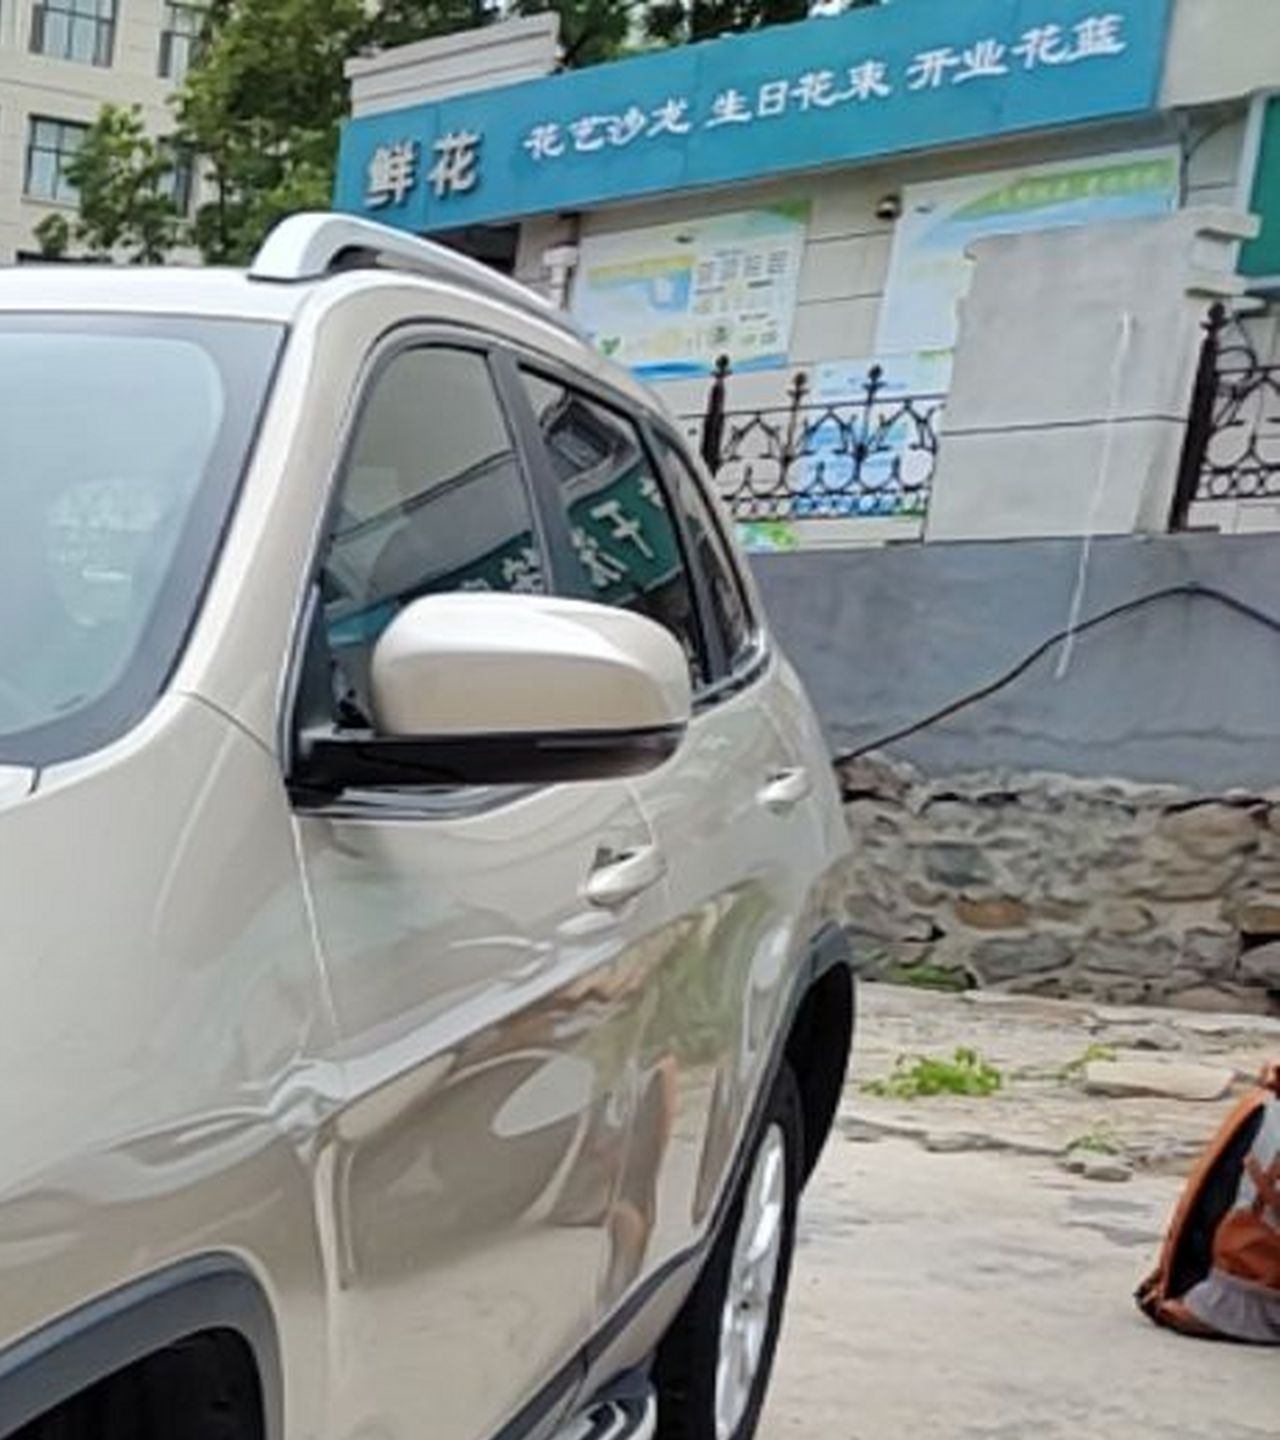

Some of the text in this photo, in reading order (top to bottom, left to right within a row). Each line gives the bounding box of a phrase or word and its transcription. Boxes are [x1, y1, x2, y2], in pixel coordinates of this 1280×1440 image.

[363, 128, 481, 209] 鲜花
[522, 97, 691, 160] 花艺沙龙
[704, 59, 891, 129] 生日花束
